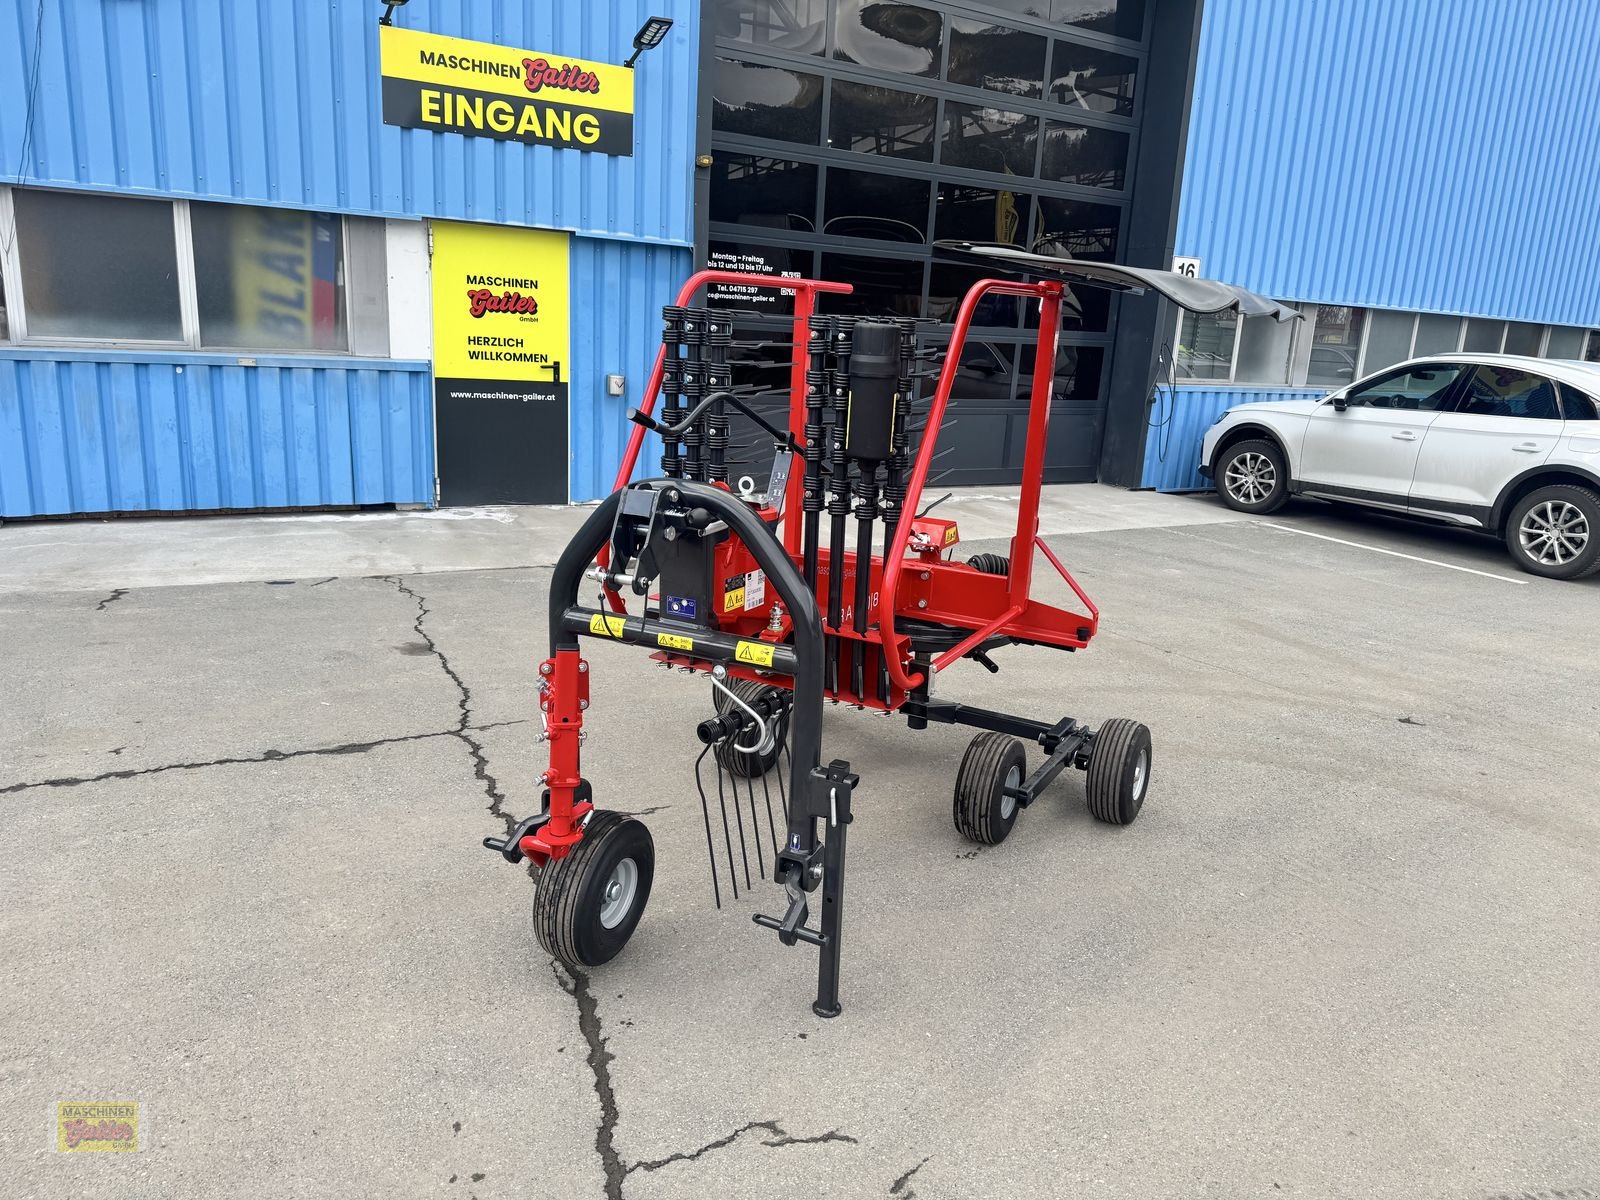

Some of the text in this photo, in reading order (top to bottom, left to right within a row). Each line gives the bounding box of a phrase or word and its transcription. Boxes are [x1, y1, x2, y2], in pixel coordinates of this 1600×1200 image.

[420, 50, 601, 93] MASCHINEN Gailer
[420, 88, 601, 145] EINGANG
[712, 252, 737, 262] Montag
[742, 255, 764, 264] Freitag
[1178, 262, 1195, 278] 16
[466, 275, 538, 289] MASCHINEN
[467, 289, 538, 318] Gailer
[467, 335, 524, 348] HERZLICH
[468, 350, 548, 363] WILLKOMMEN
[450, 391, 556, 402] www.maschinen-gailer.at
